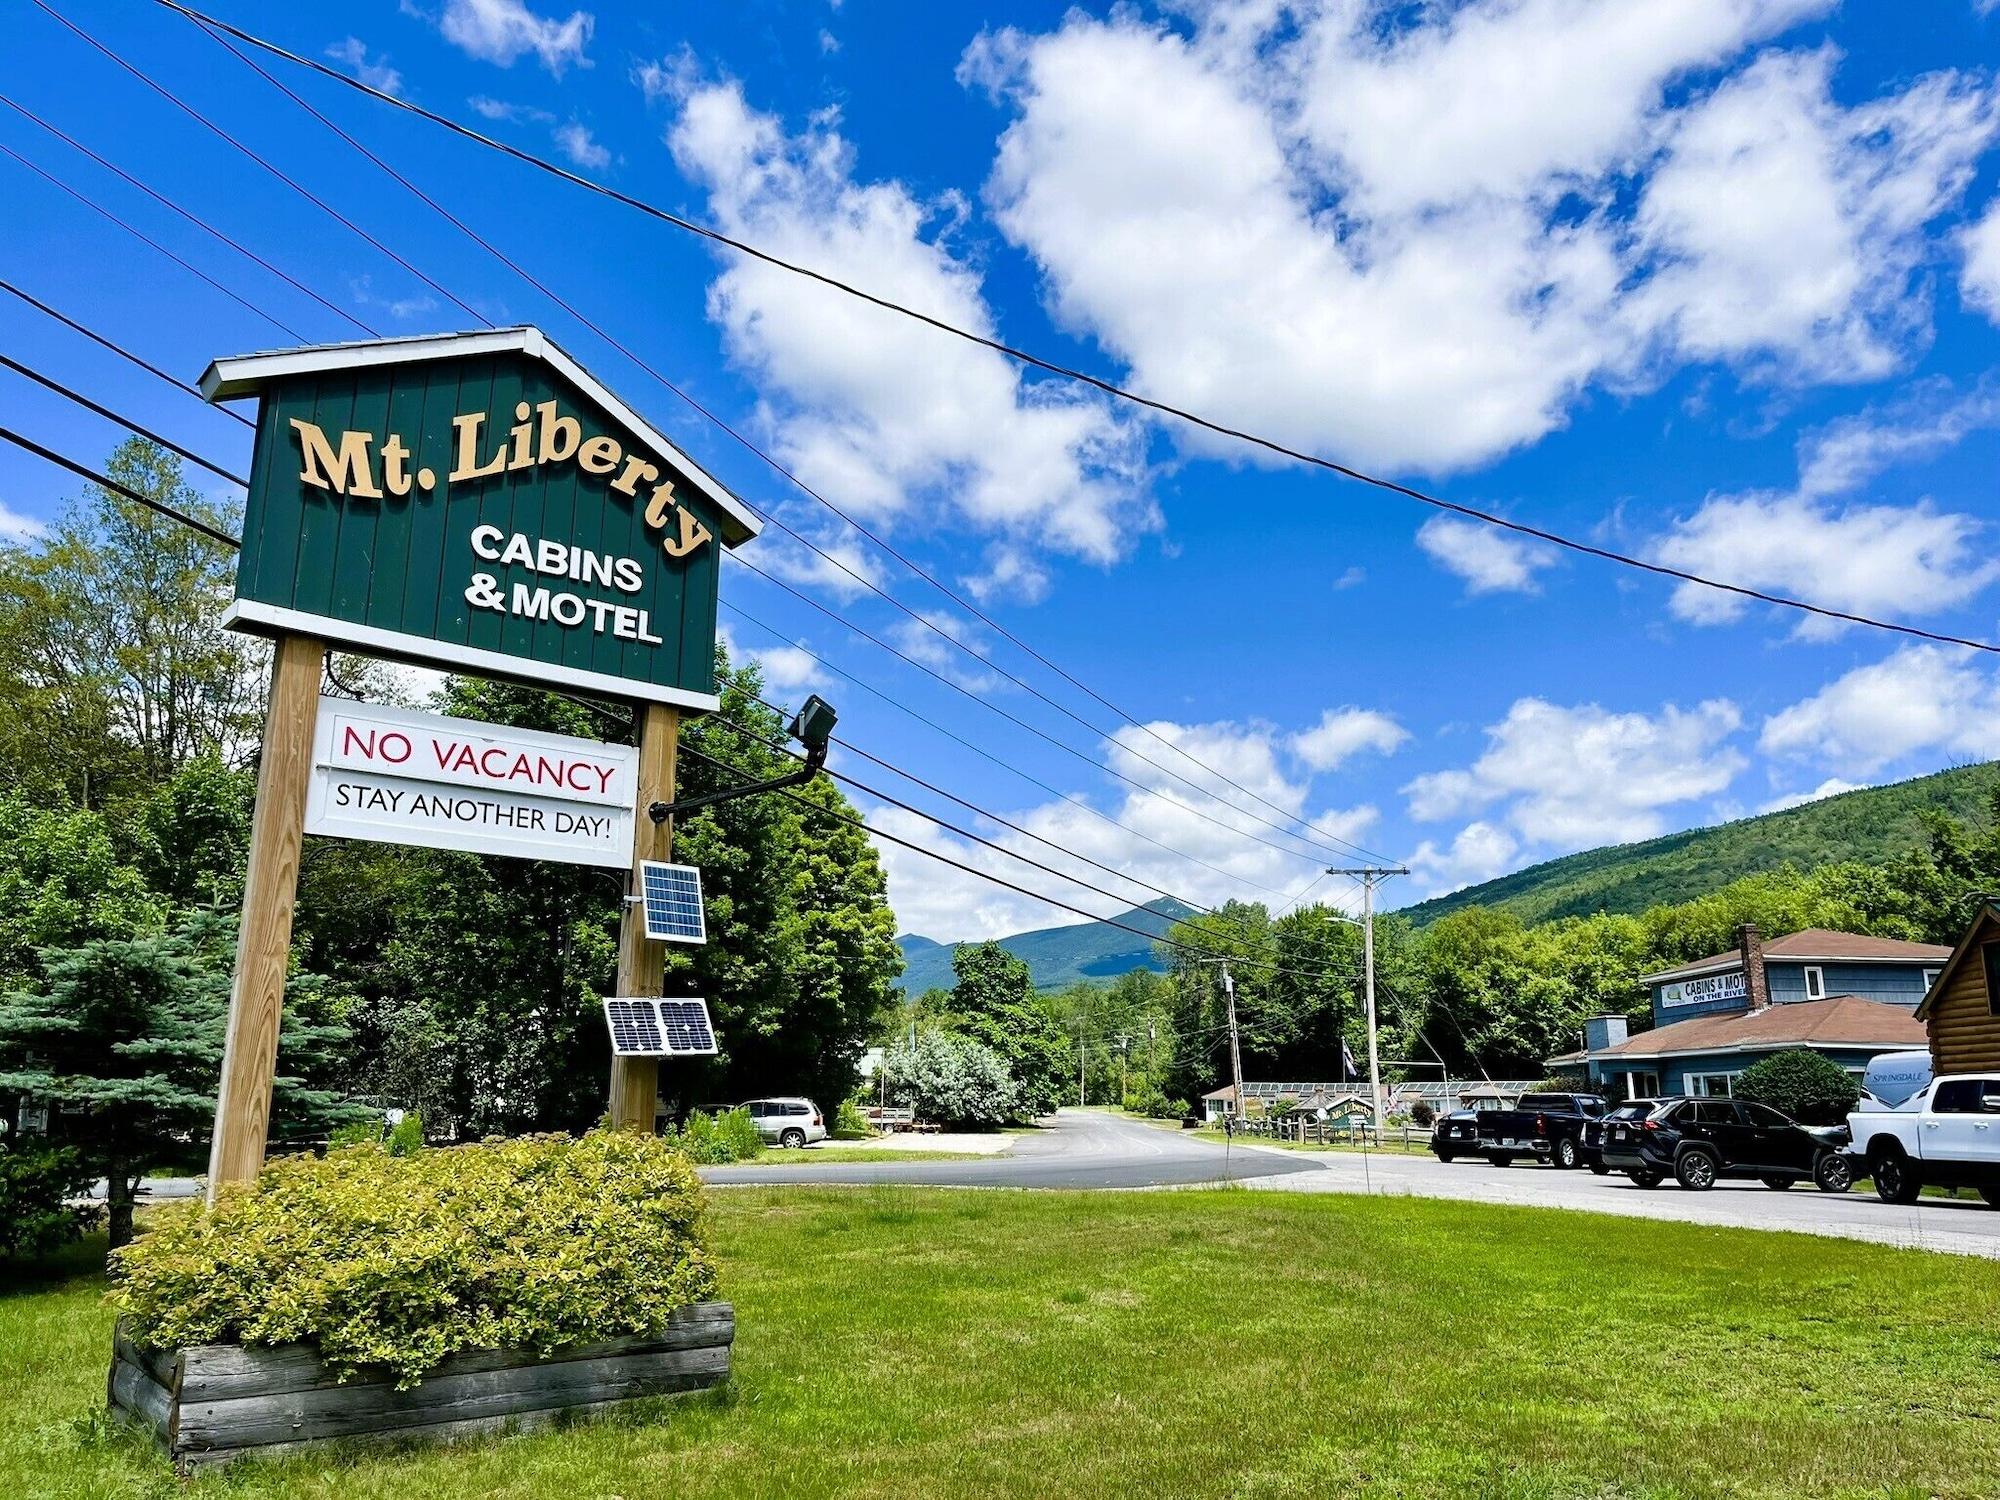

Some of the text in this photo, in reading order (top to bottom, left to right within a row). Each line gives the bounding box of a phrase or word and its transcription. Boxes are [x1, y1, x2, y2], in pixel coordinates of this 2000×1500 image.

[289, 399, 713, 558] Mt. Liberty
[470, 524, 644, 593] CABINS
[343, 726, 615, 794] NO VACANCY
[335, 783, 611, 839] STAY ANOTHER DAY!
[1685, 980, 1716, 997] CABINS
[1717, 978, 1723, 989] &
[1693, 995, 1705, 1003] ON
[1706, 992, 1722, 1000] THE
[1873, 1072, 1923, 1082] SPRINGDALE
